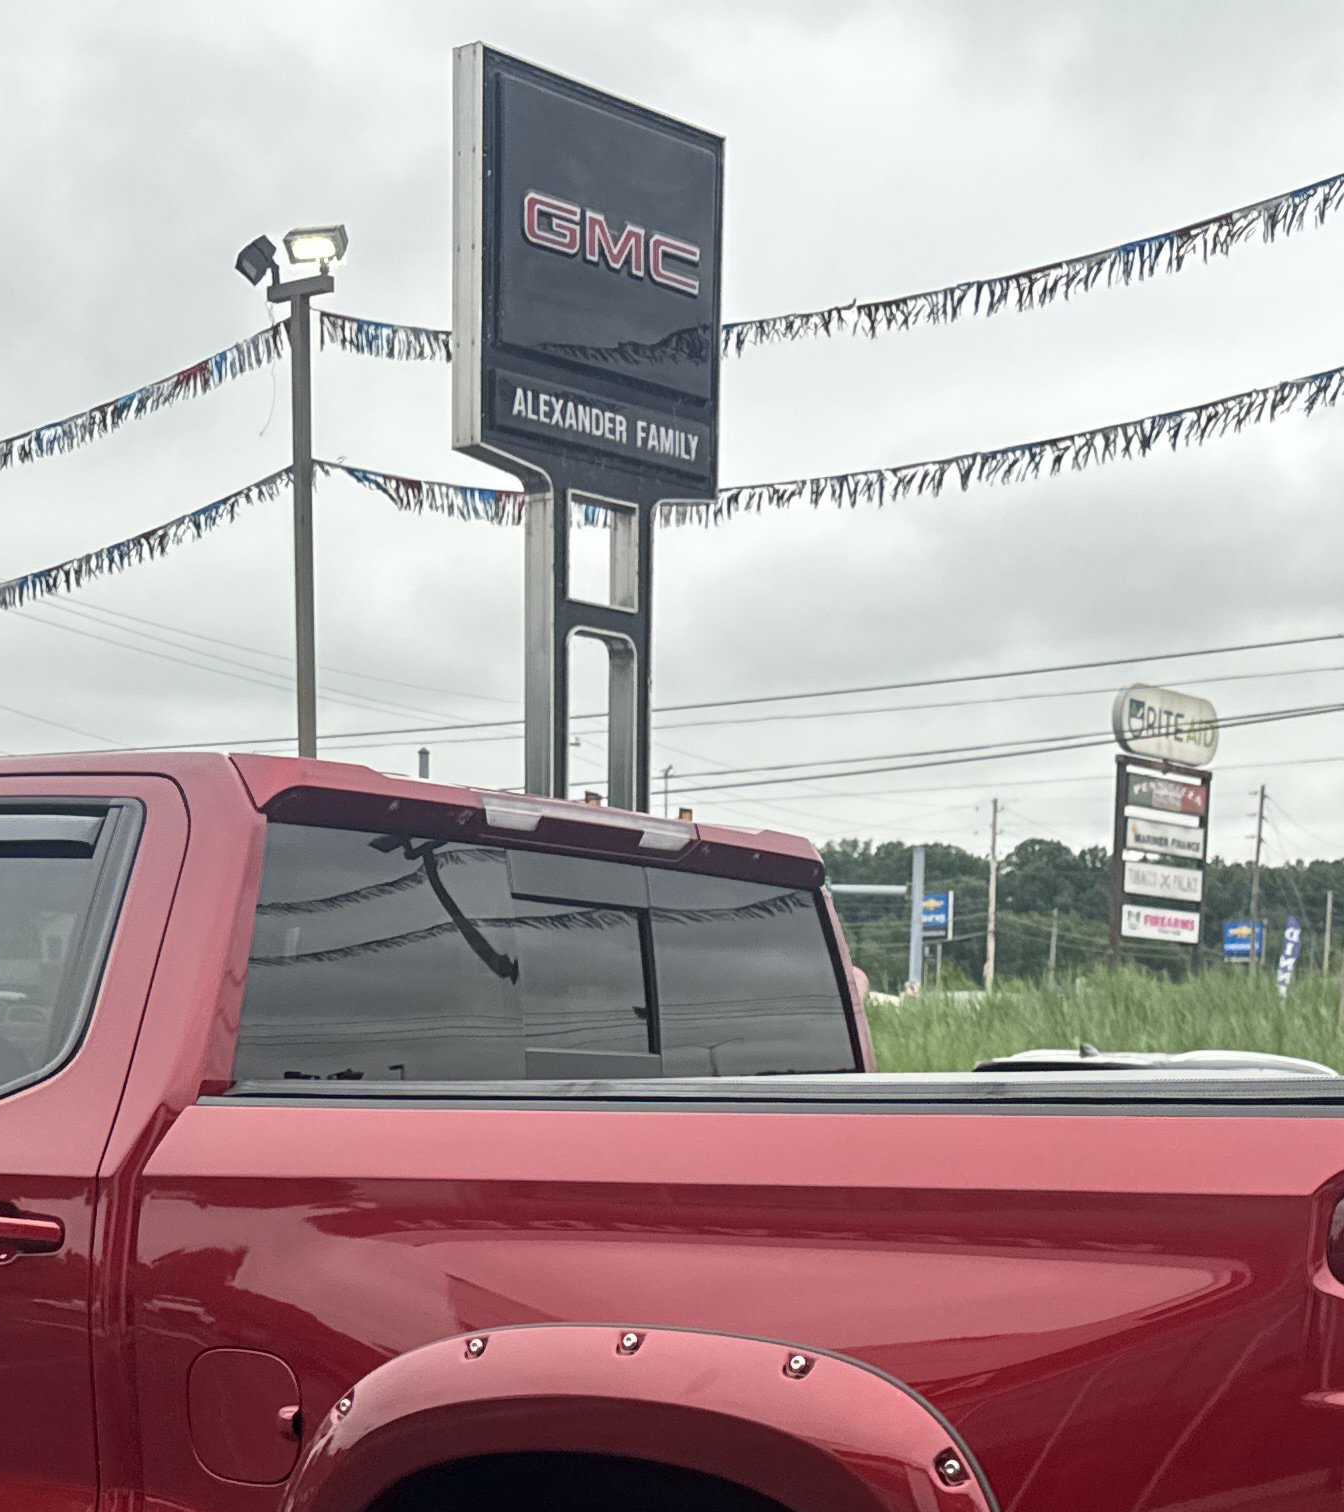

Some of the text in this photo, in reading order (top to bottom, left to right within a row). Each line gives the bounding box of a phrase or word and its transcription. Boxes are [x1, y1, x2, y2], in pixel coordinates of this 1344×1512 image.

[524, 191, 701, 296] GMC
[512, 388, 699, 461] ALEXANDER FAMILY
[1147, 706, 1185, 743] RITE
